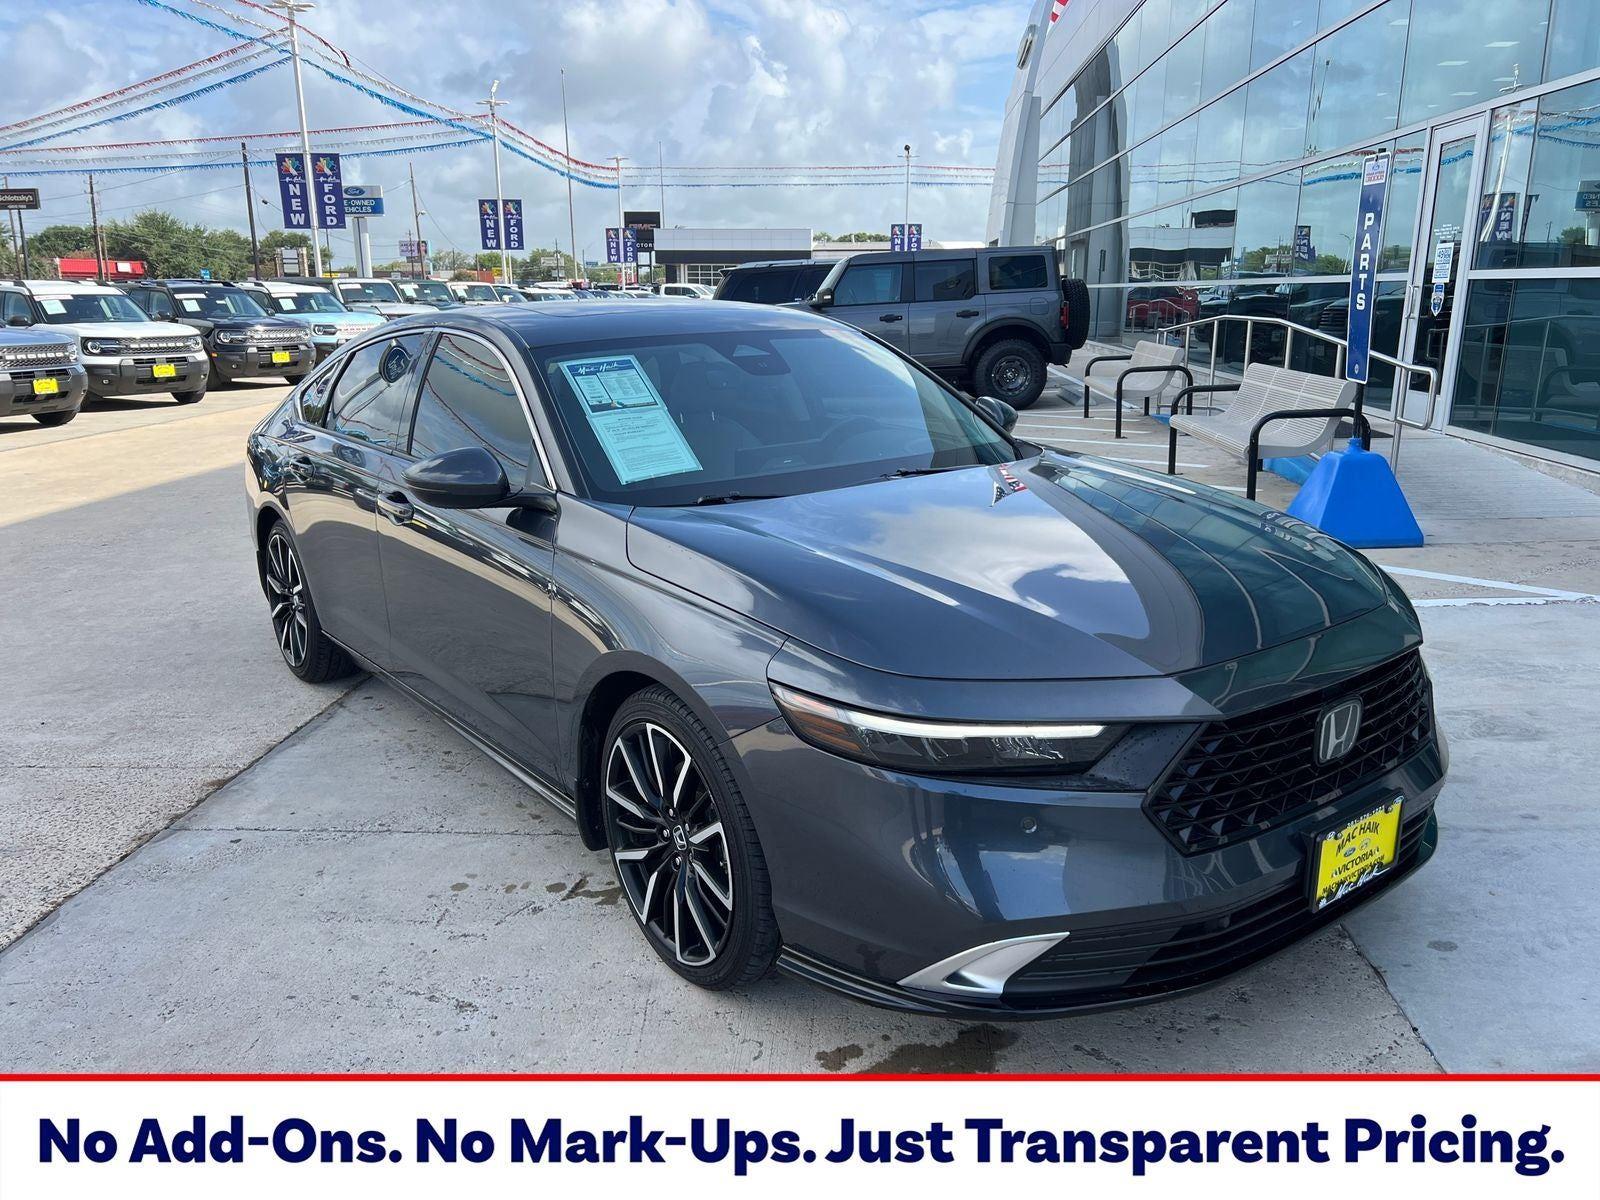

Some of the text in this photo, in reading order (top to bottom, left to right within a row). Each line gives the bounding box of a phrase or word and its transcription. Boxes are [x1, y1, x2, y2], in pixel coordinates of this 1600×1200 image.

[288, 183, 305, 225] NEW
[323, 183, 338, 226] FORD
[486, 219, 497, 248] NEW
[509, 219, 519, 248] FORD
[610, 241, 618, 262] NEW
[626, 241, 634, 262] FORD
[1356, 212, 1374, 310] PARTS
[1336, 827, 1358, 856] MAC
[1358, 820, 1380, 836] HAIK
[1337, 849, 1374, 876] VICTORIA
